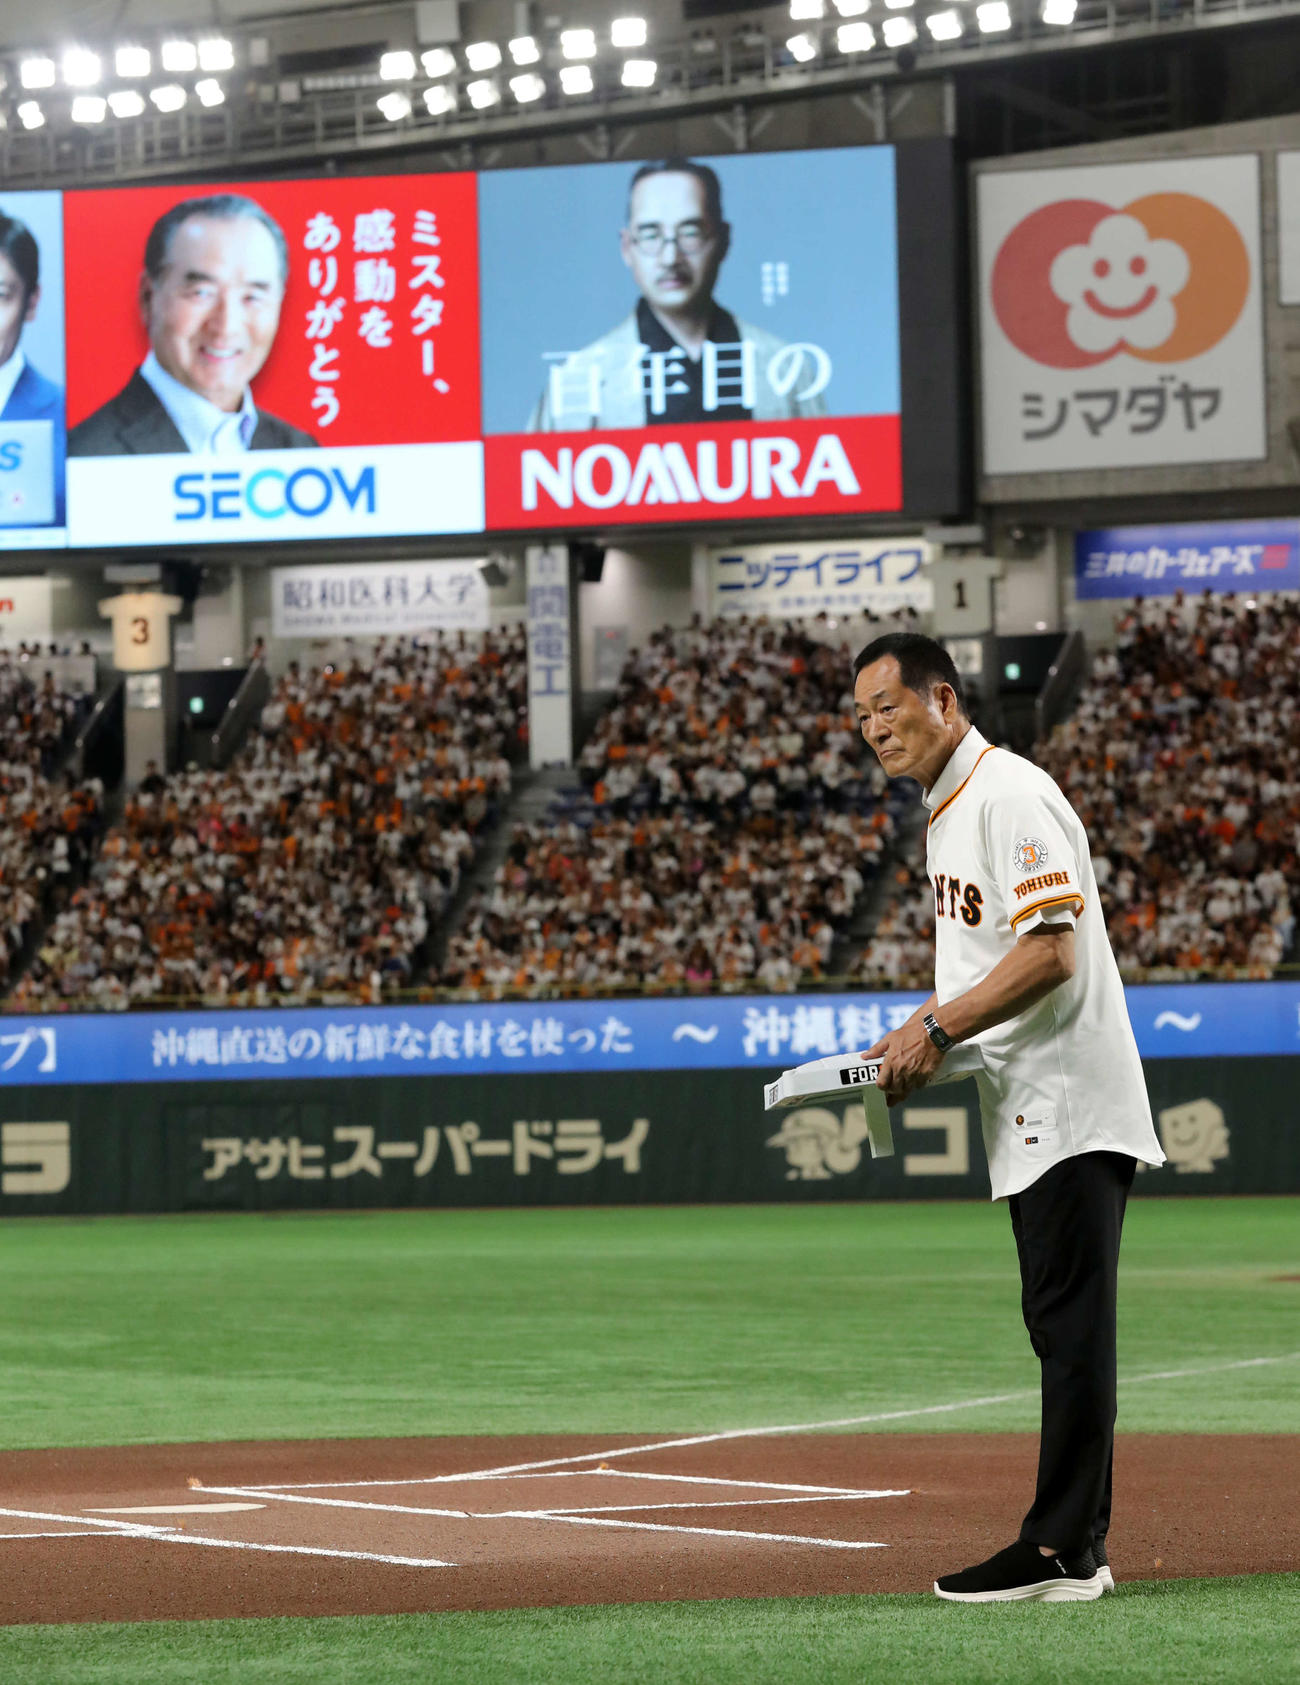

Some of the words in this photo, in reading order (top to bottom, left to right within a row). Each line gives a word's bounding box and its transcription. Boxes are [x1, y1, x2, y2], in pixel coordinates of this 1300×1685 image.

[352, 208, 397, 349] 感動を
[408, 209, 450, 395] ミスター、
[303, 211, 345, 427] ありがとう
[541, 340, 833, 418] 百年目の
[1021, 374, 1223, 441] シマダヤ
[173, 466, 376, 521] SECOM
[521, 433, 862, 511] NOMURA
[282, 573, 476, 610] 昭和医科大学
[718, 548, 923, 591] ニッテイライフ
[954, 580, 968, 609] 1
[132, 616, 149, 645] 3
[1023, 846, 1036, 864] 3
